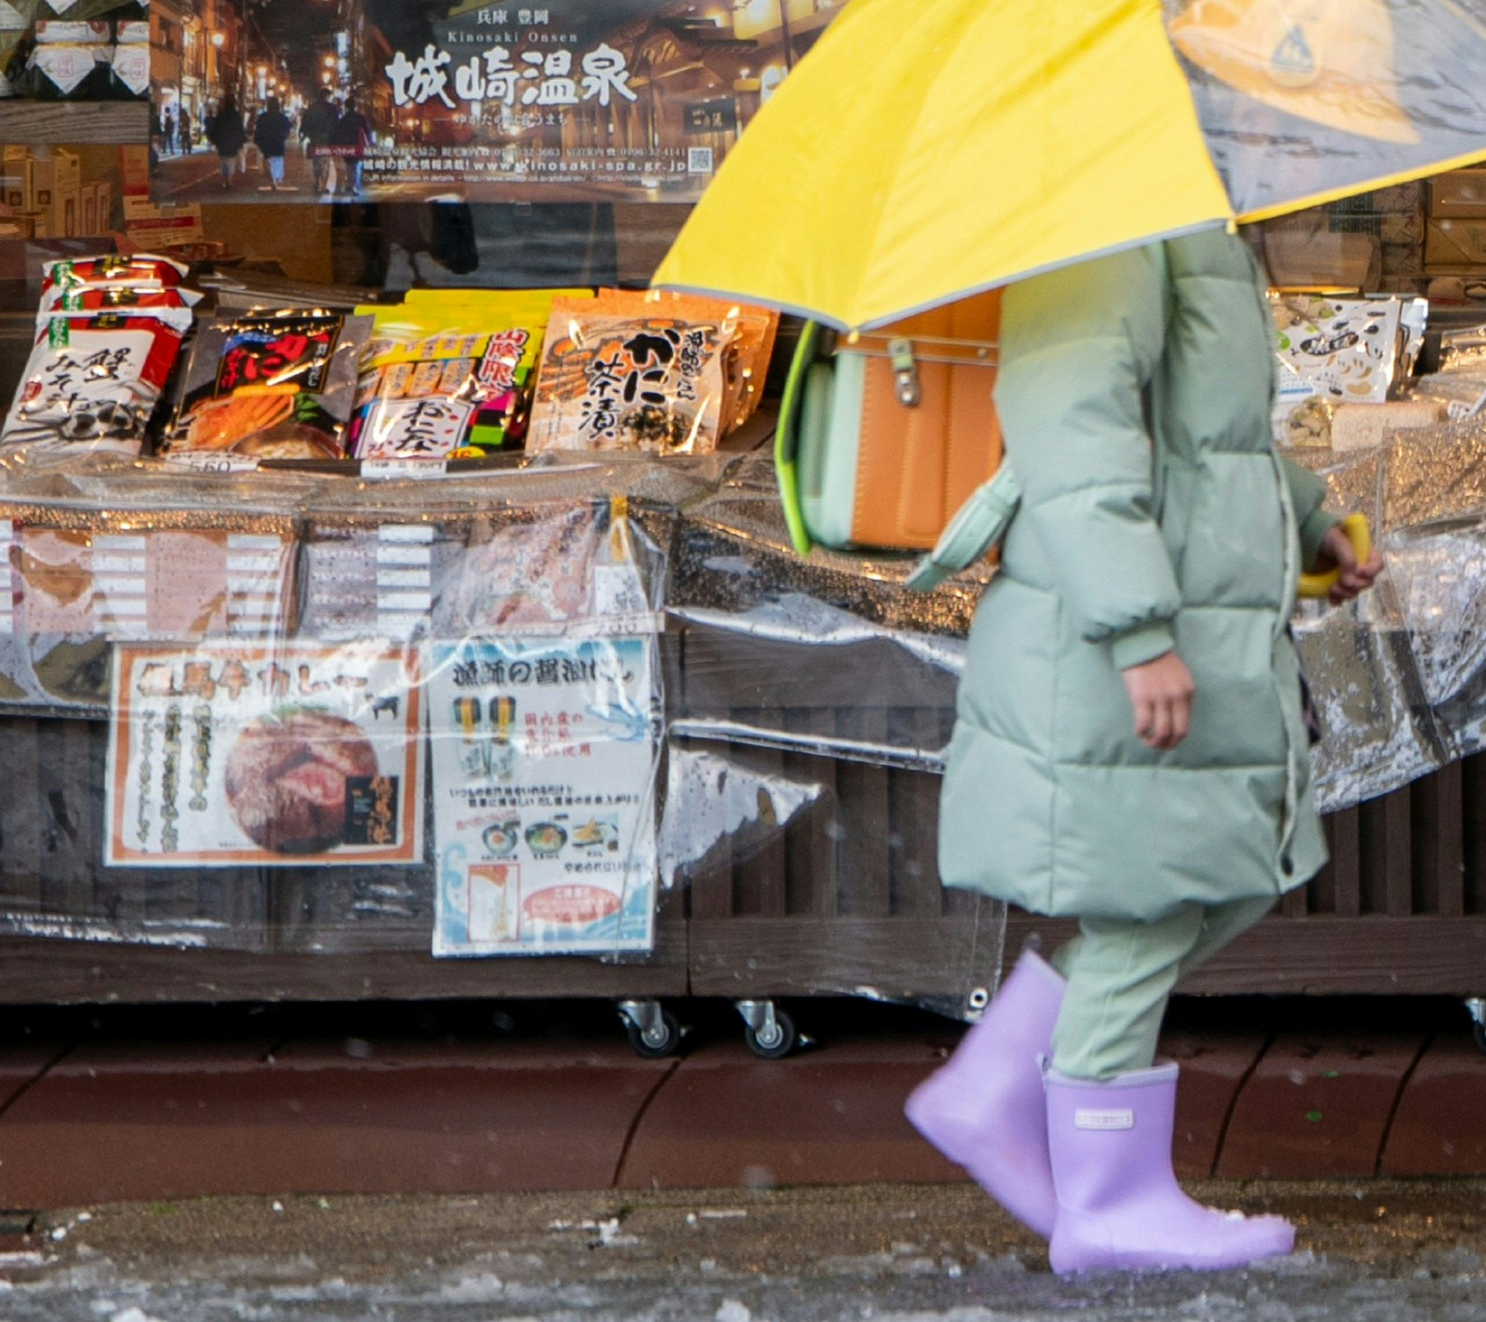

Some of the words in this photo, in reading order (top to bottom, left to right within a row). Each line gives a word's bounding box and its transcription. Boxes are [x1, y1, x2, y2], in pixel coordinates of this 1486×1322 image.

[447, 30, 519, 44] Kinosaki
[528, 30, 579, 44] Onsen
[476, 8, 508, 26] 兵庫
[517, 8, 550, 26] 豊岡
[383, 43, 639, 109] 城崎温泉
[453, 111, 570, 127] ゆかたの合うまち
[45, 353, 89, 413] みそ汁
[579, 351, 628, 442] 茶漬
[621, 328, 681, 405] かに
